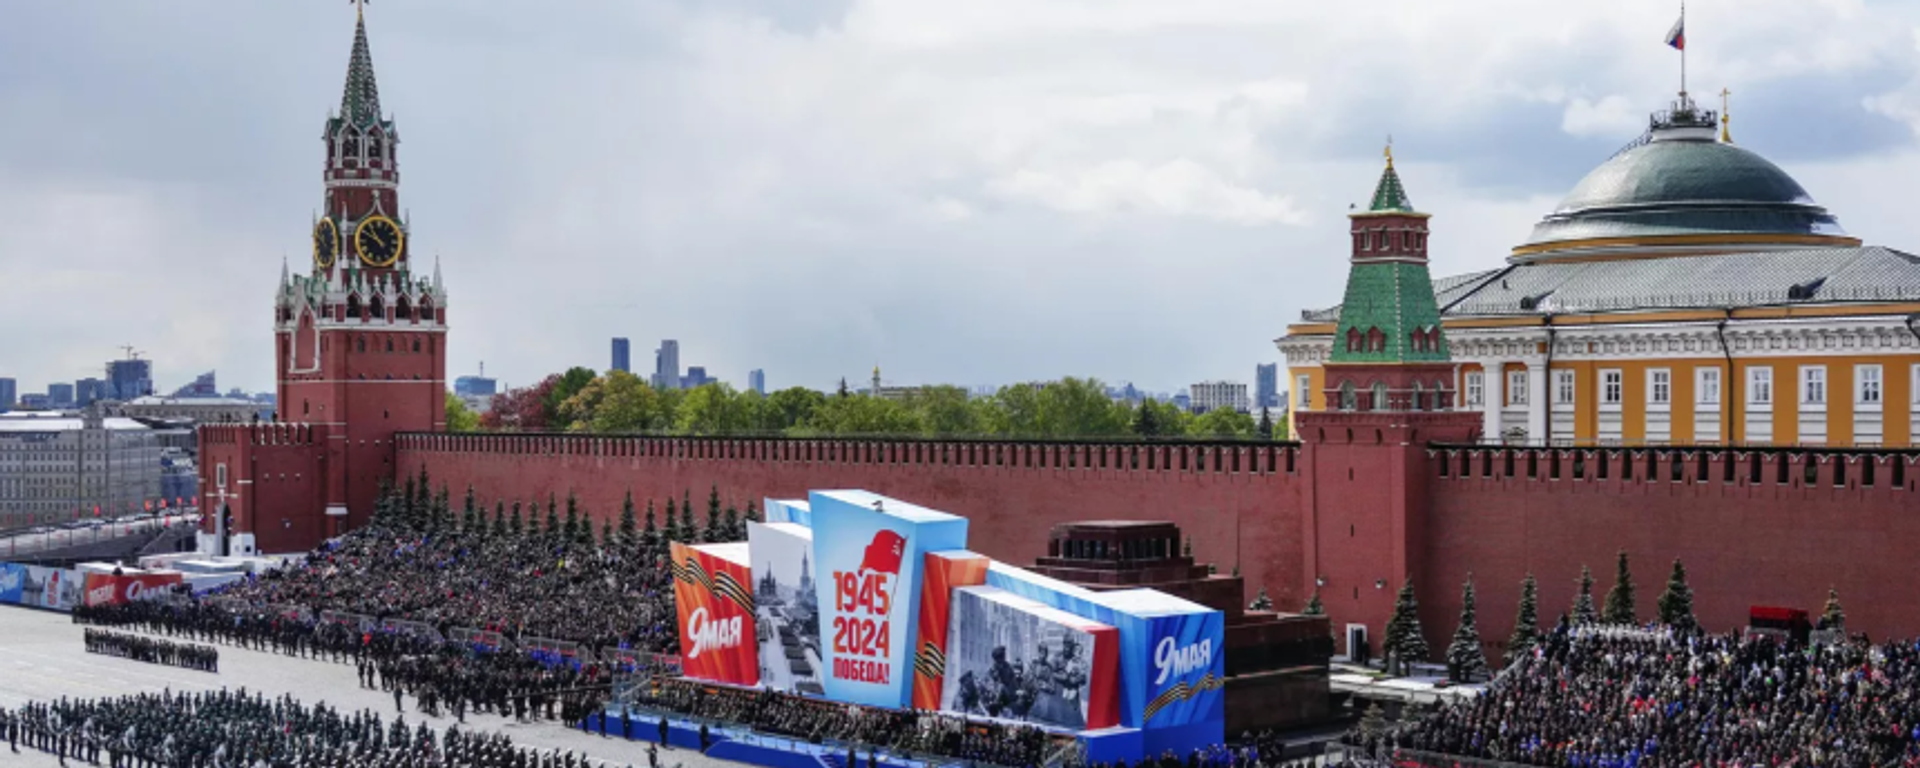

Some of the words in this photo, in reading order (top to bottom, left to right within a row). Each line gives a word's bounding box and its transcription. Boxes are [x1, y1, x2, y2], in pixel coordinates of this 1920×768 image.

[833, 571, 890, 615] 1945
[833, 616, 890, 659] 2024
[833, 657, 890, 685] ПОБЕДА!
